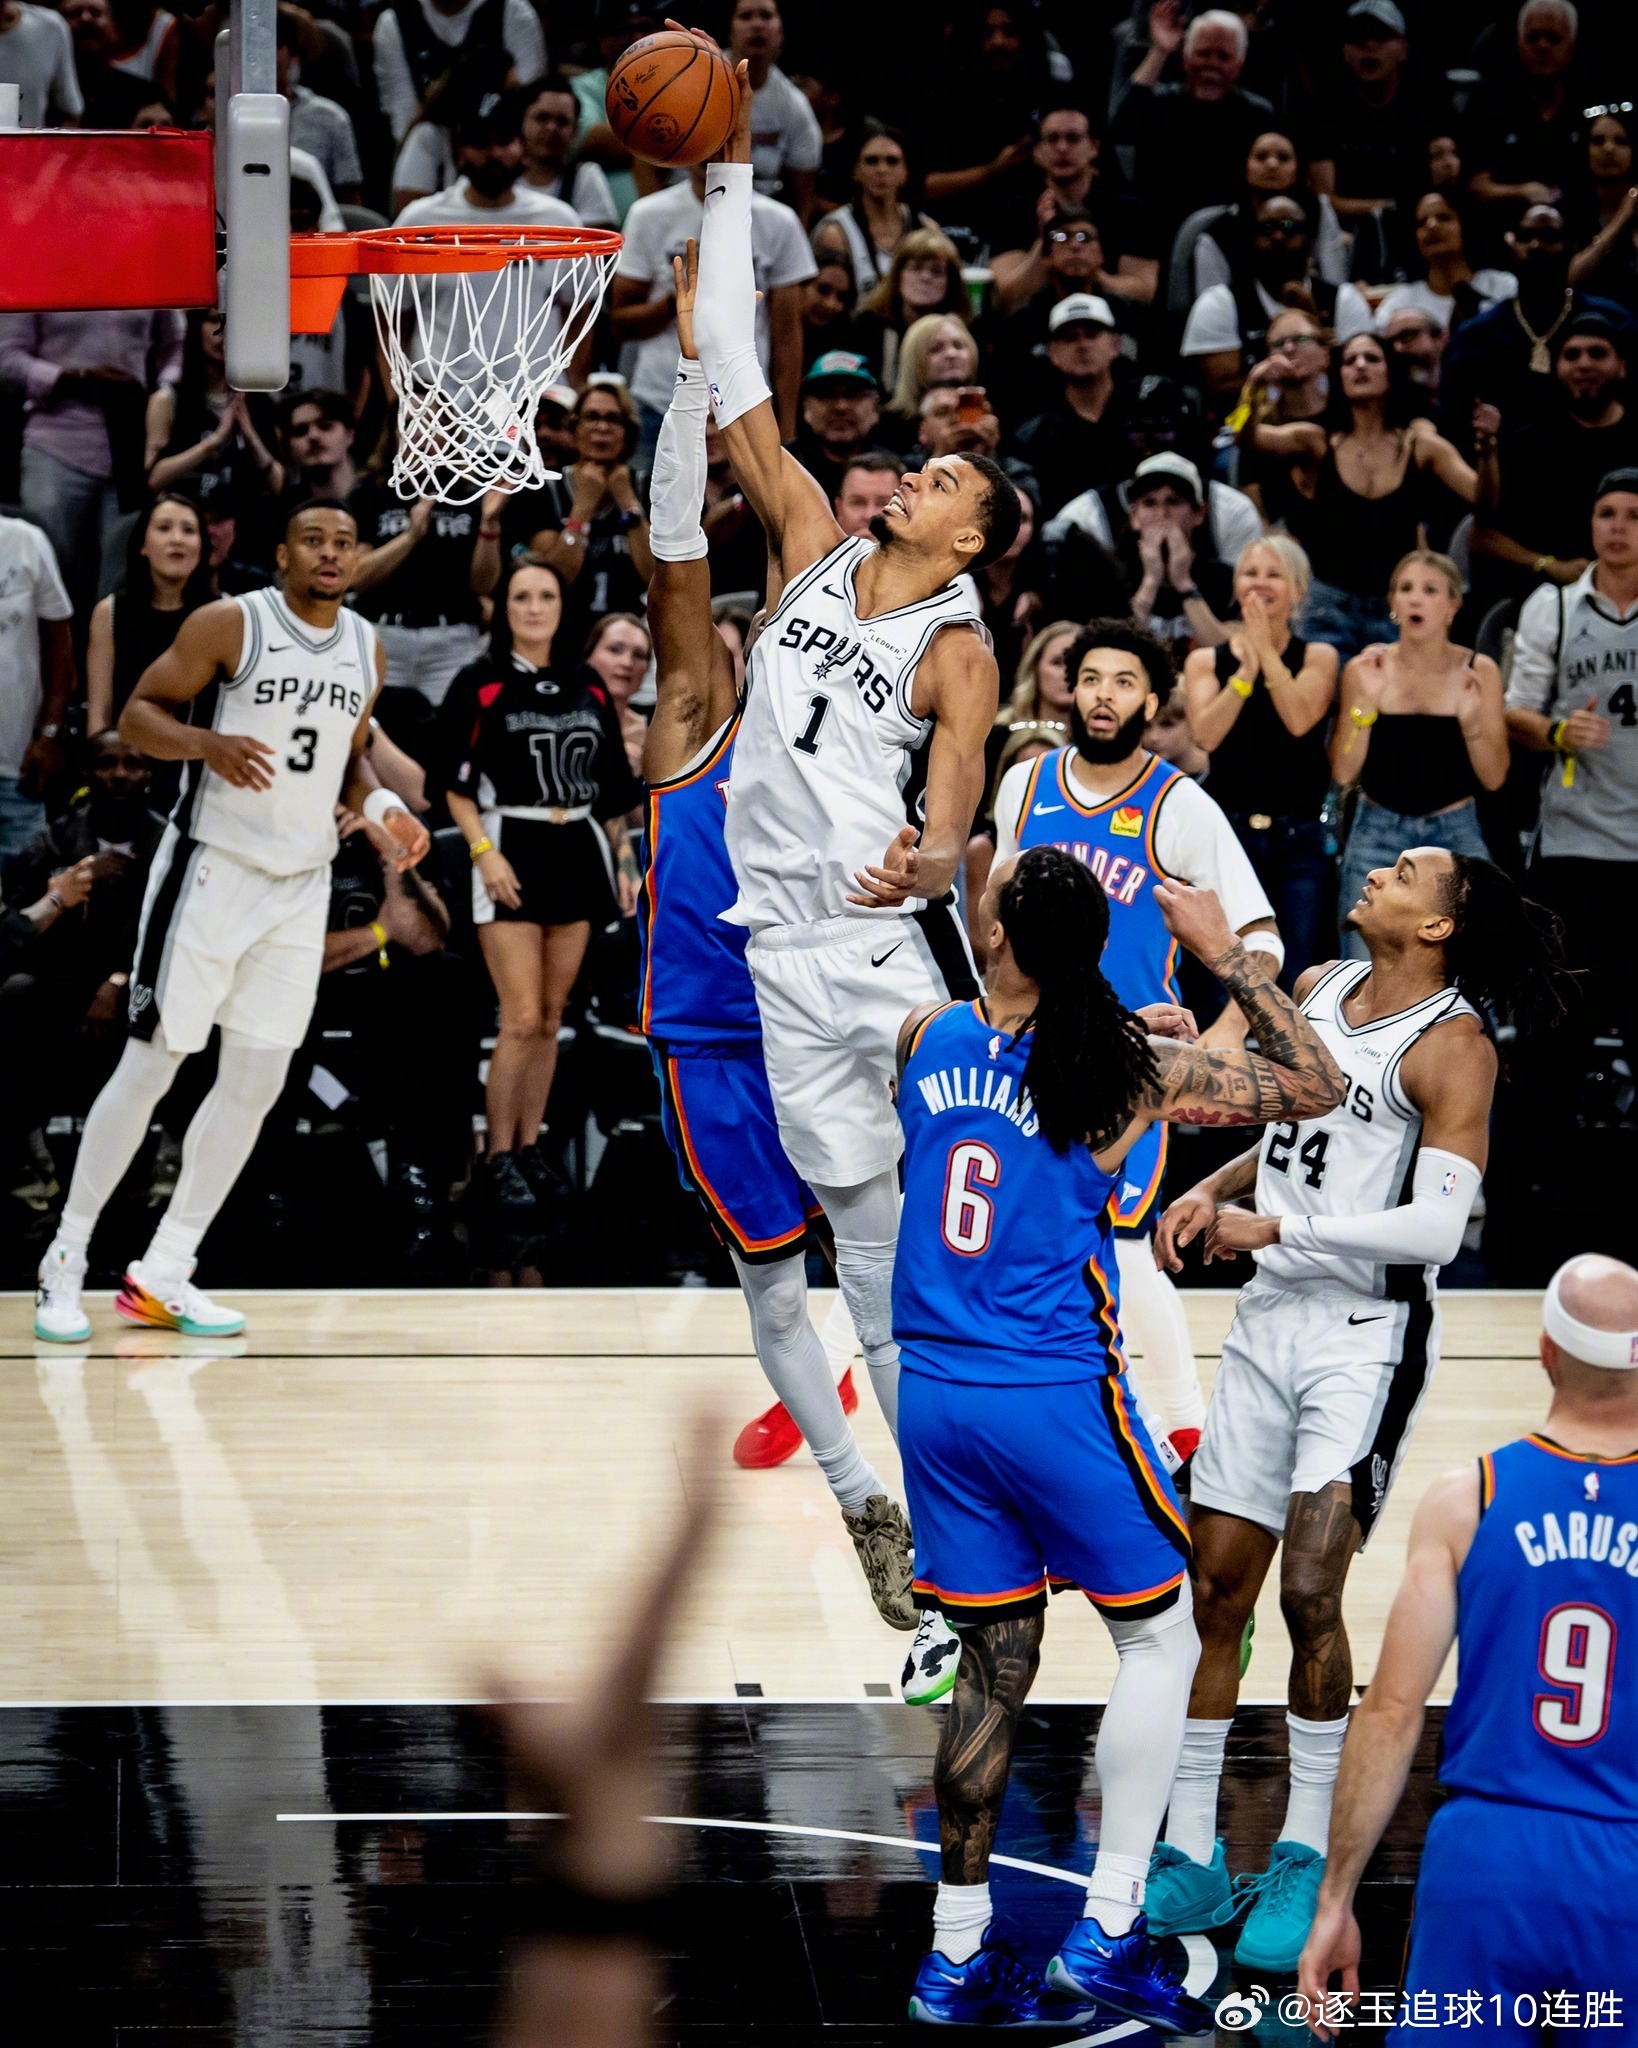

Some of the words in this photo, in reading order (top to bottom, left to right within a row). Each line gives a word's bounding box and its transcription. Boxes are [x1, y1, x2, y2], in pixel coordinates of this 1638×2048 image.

[779, 617, 893, 714] SPURS
[870, 634, 900, 654] LEDGER
[1567, 656, 1597, 689] SAN
[254, 677, 362, 718] SPURS
[790, 692, 832, 759] 1
[1608, 684, 1637, 726] 4
[286, 726, 319, 773] 3
[529, 731, 599, 807] 10
[1265, 1121, 1332, 1194] 24
[940, 1138, 1002, 1258] 6
[1532, 1601, 1618, 1748] 9
